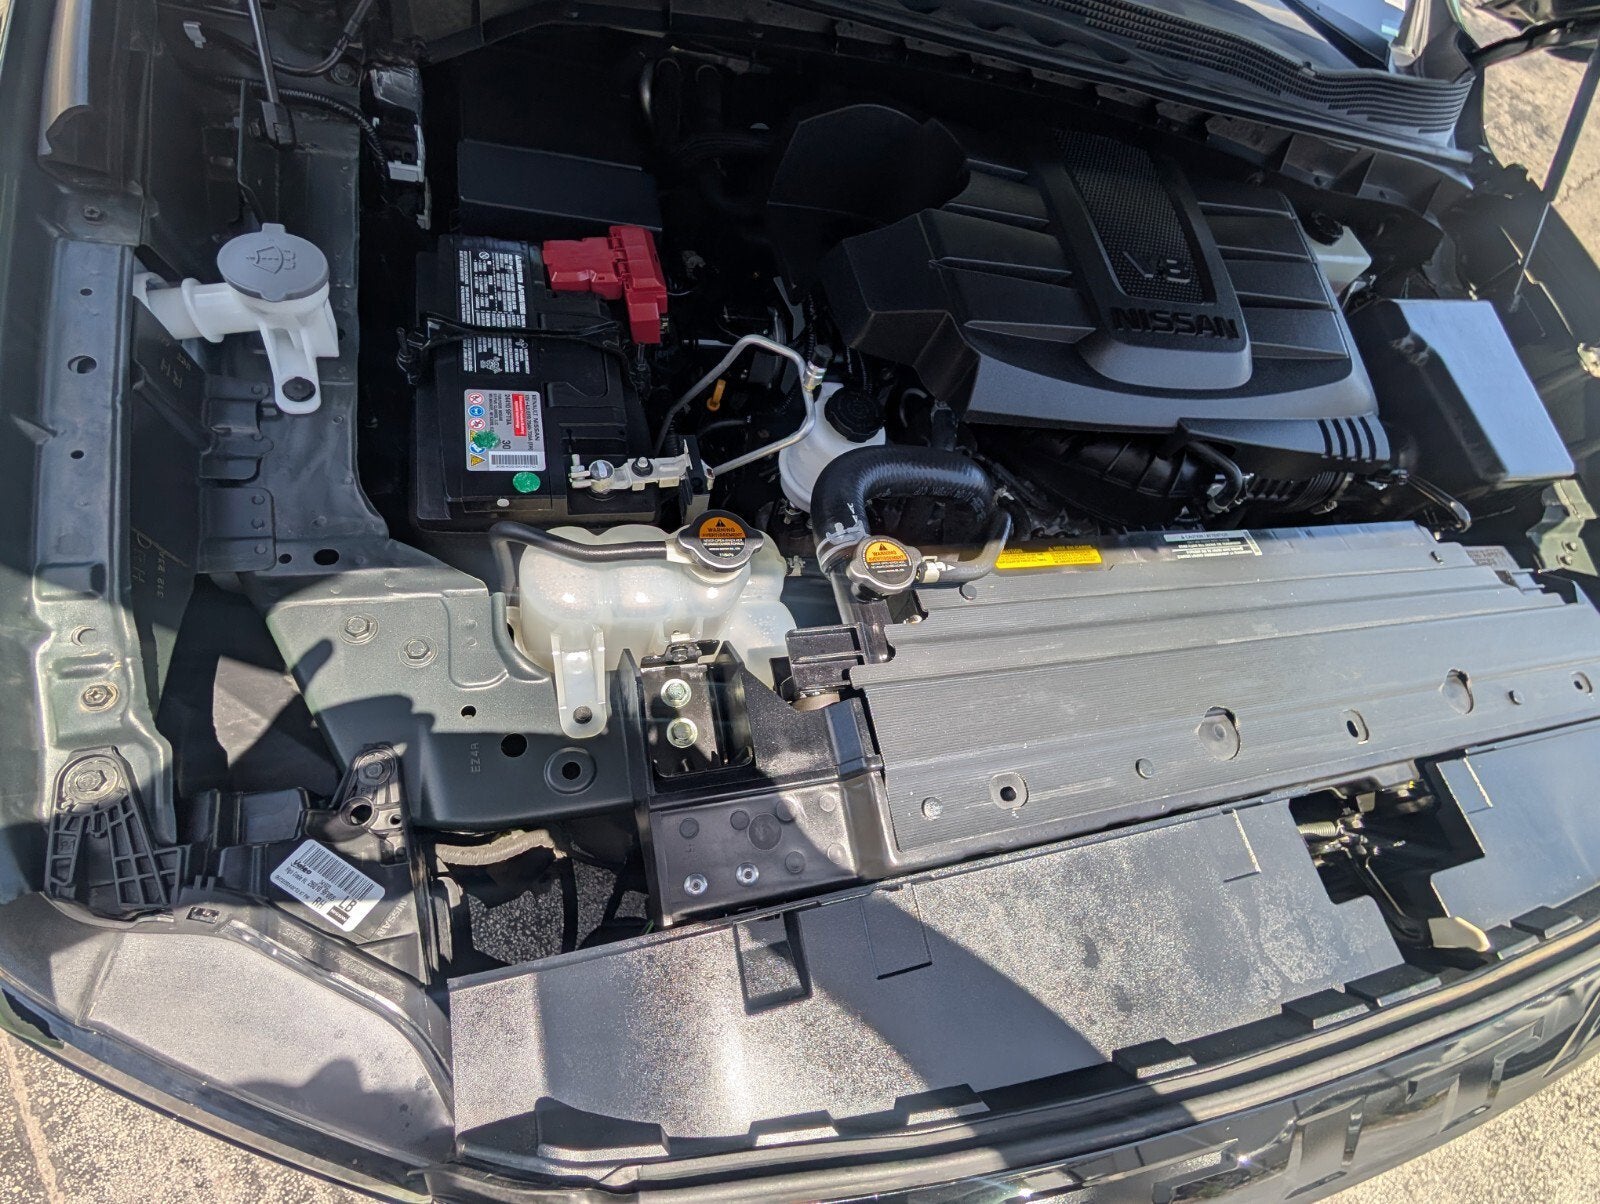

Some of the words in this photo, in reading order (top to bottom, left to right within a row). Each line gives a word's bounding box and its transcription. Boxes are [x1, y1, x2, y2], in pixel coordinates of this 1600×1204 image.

[1121, 250, 1191, 284] V8
[1109, 306, 1240, 340] NISSAN
[531, 394, 539, 417] RENAULT
[533, 417, 541, 441] NISSAN
[502, 440, 511, 450] 30
[312, 897, 327, 910] RH
[338, 895, 358, 913] LB
